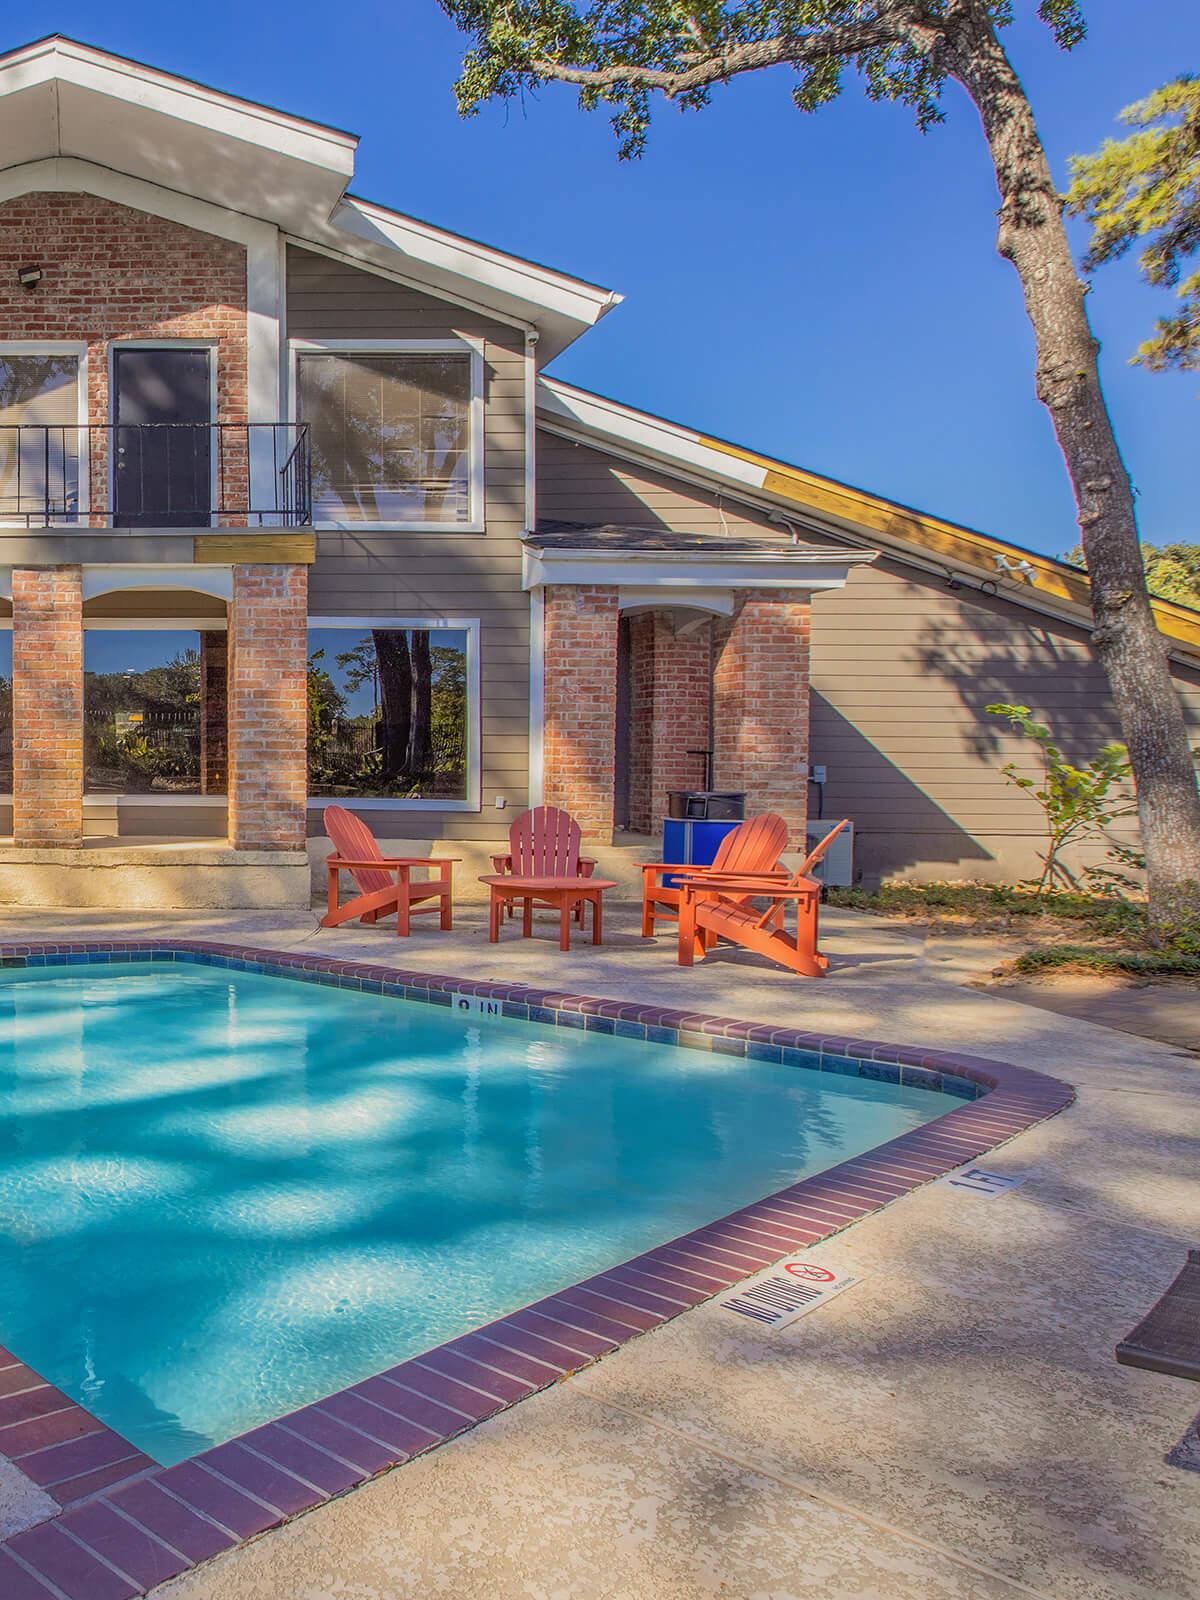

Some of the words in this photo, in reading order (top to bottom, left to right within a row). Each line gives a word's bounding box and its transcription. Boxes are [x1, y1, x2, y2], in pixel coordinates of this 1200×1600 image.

[481, 1001, 498, 1015] IN
[949, 1180, 995, 1193] 1
[960, 1169, 1015, 1187] FT
[741, 1276, 824, 1313] DIVING
[719, 1299, 783, 1324] NO
